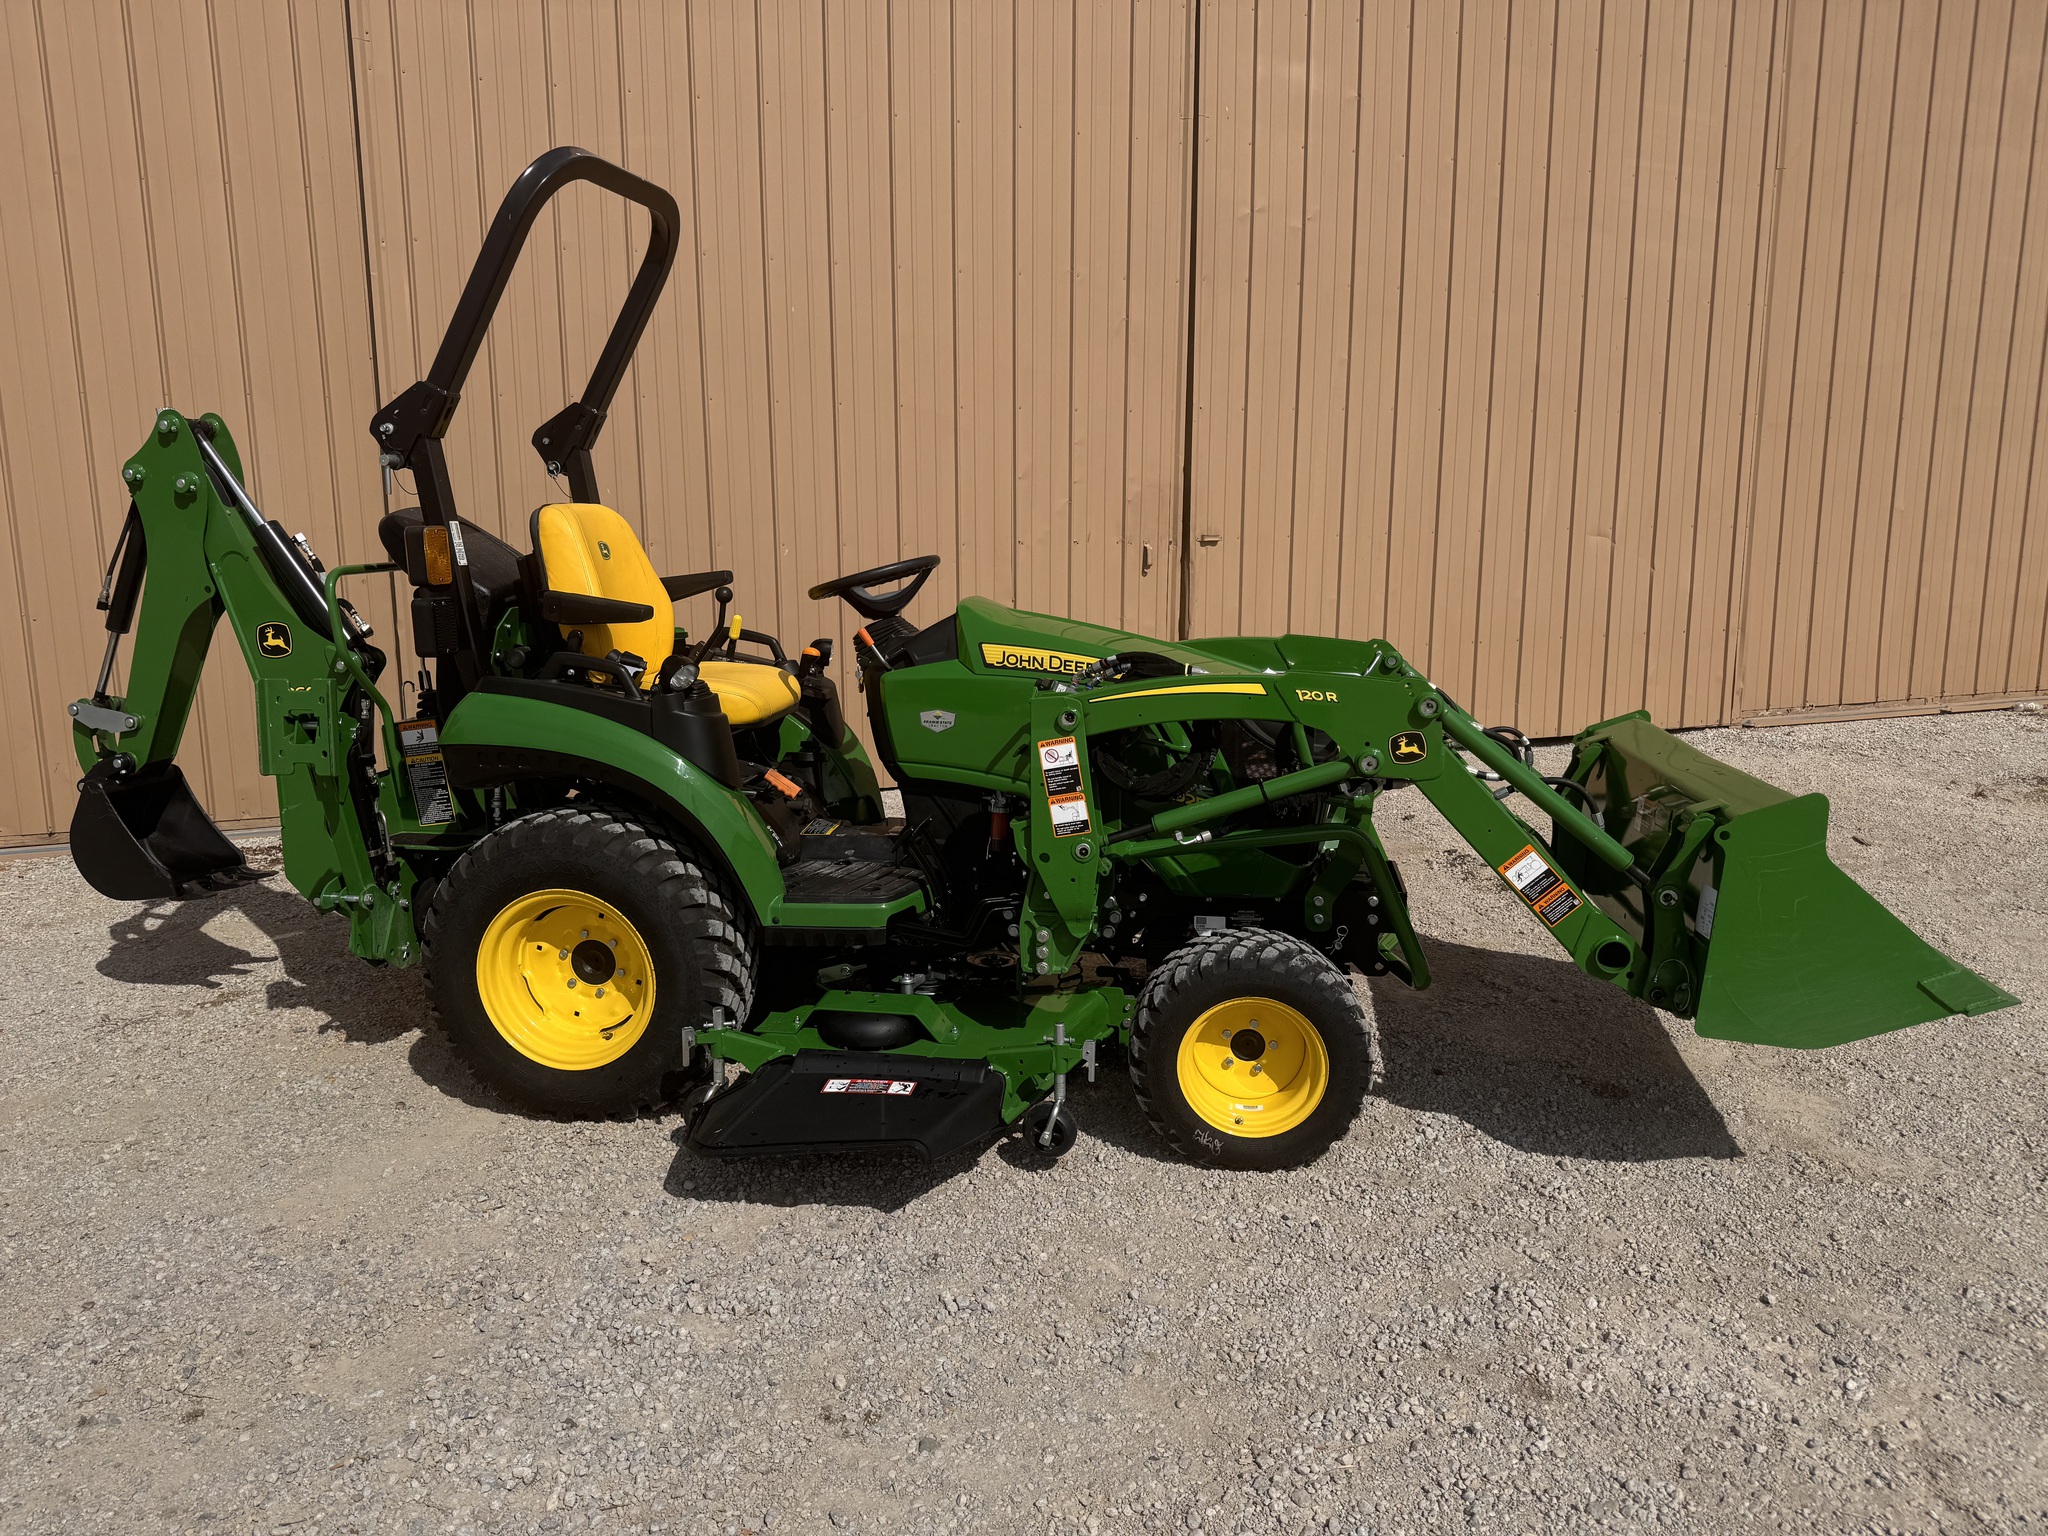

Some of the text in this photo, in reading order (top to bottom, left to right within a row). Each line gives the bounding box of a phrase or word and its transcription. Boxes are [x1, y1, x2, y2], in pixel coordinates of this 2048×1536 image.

[996, 651, 1093, 673] JOHN DEE
[1295, 689, 1339, 702] 120 R
[407, 722, 432, 730] WARNING
[1045, 737, 1074, 747] WARNING
[415, 756, 438, 764] CAUTION
[1055, 794, 1084, 804] WARNING
[1509, 849, 1529, 867] WARNING
[1544, 887, 1565, 904] WARNING
